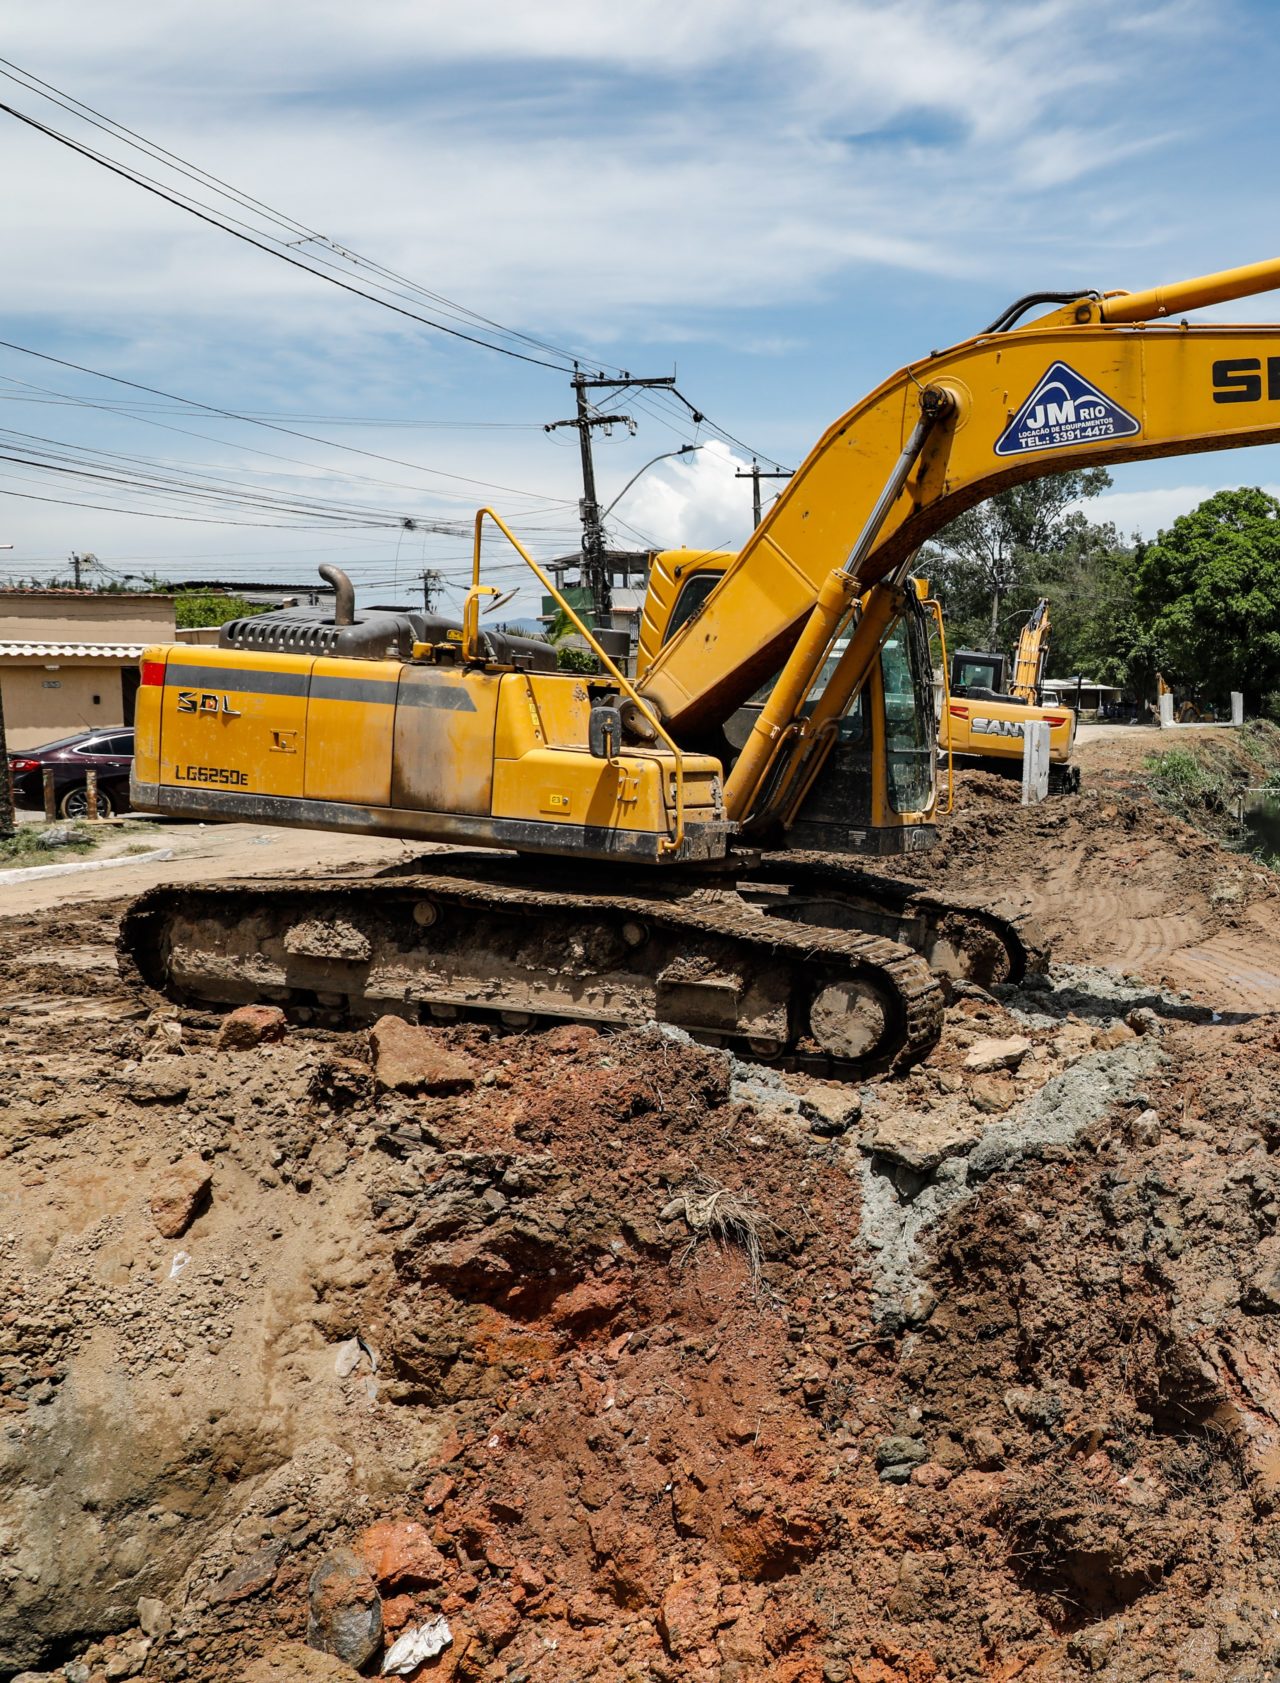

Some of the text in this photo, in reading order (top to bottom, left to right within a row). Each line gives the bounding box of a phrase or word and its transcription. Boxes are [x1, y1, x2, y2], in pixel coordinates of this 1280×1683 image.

[1026, 400, 1106, 429] JM RIO
[1061, 418, 1113, 431] EQUIPAMENTOS
[1019, 424, 1115, 448] TEL.: 3391-4473
[175, 765, 248, 786] LG6250E
